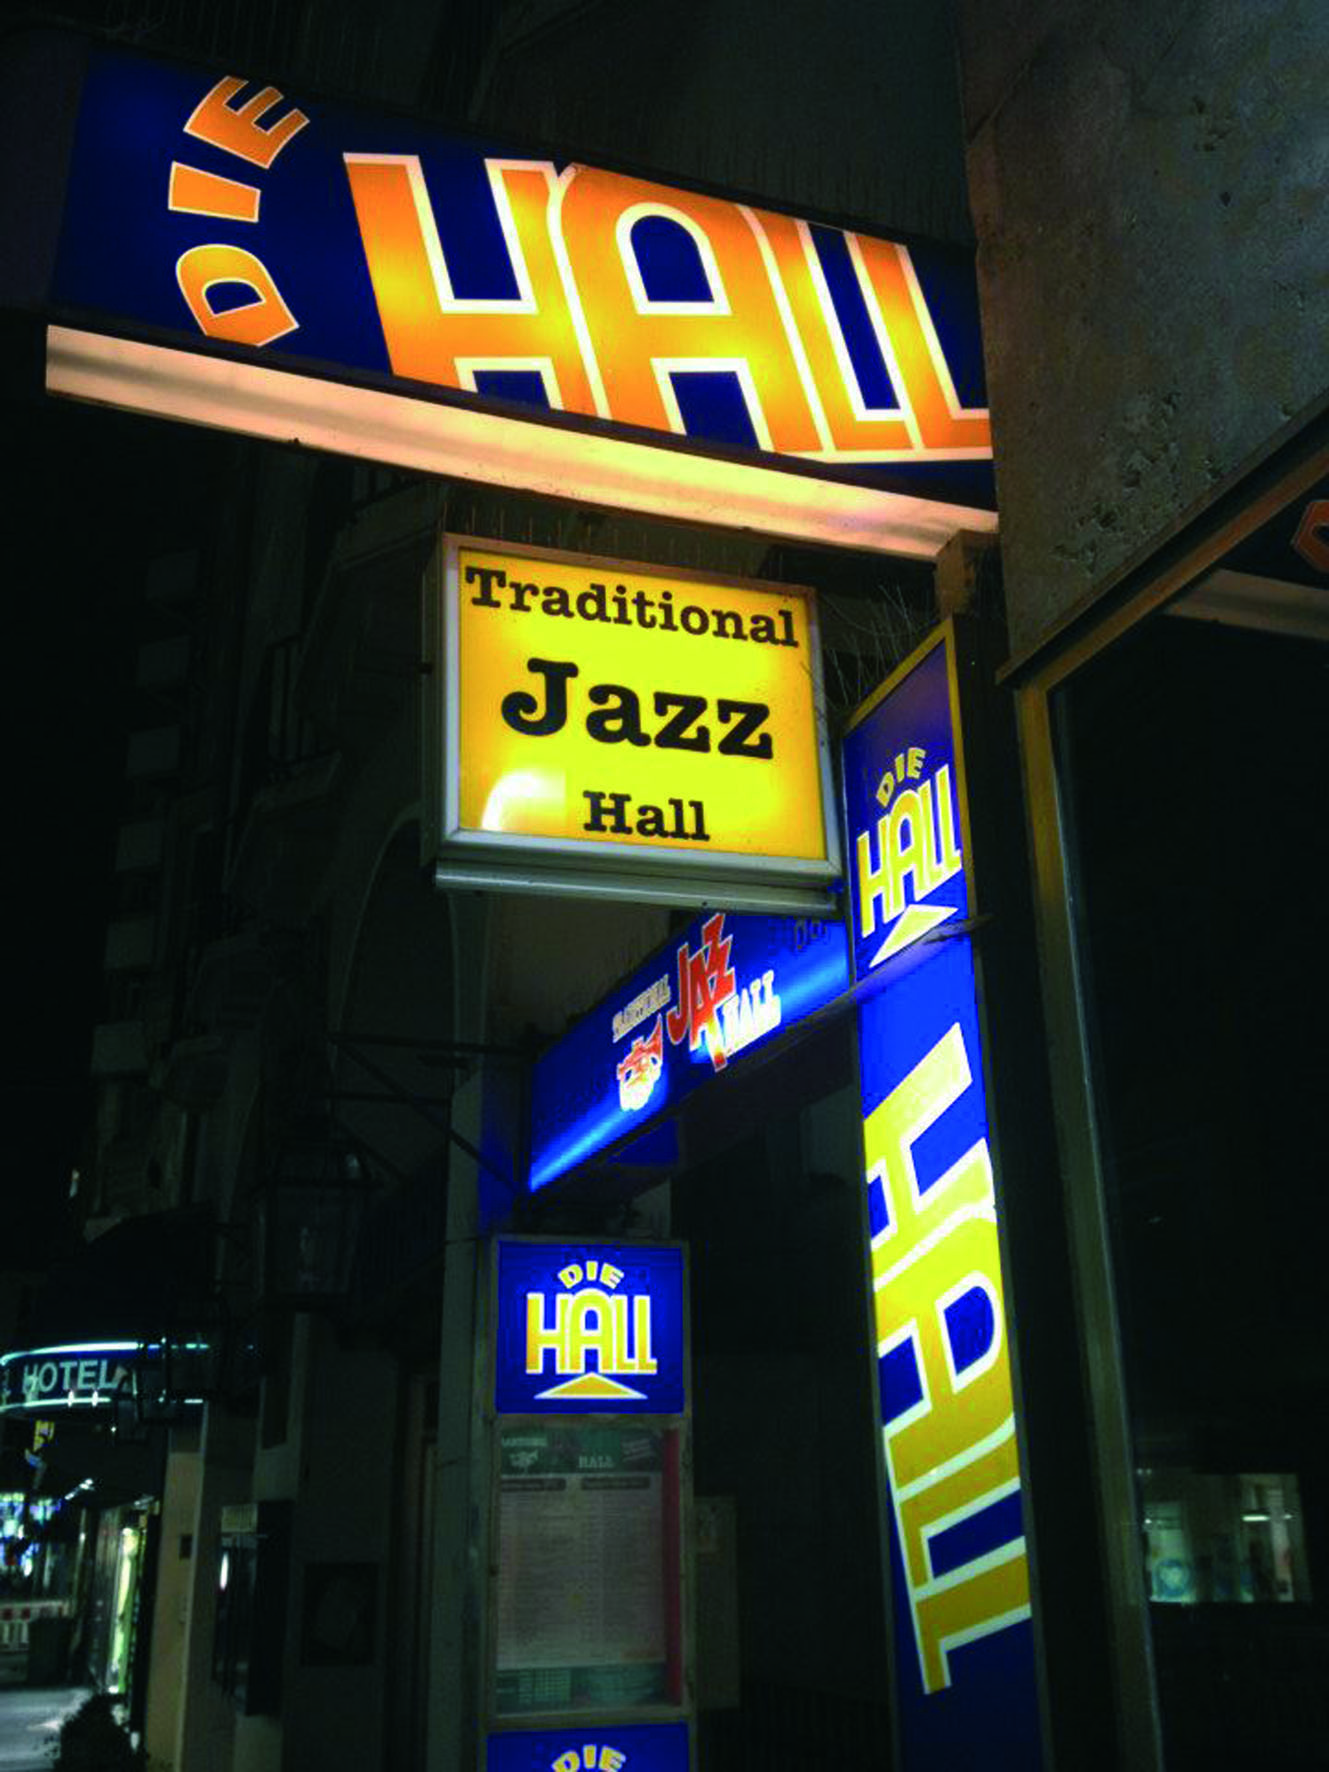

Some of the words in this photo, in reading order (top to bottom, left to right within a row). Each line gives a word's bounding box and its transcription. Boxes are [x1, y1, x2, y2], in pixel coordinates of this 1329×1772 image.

[169, 75, 310, 346] DIE
[343, 152, 994, 464] HALL
[464, 565, 799, 648] Traditional
[501, 657, 773, 760] Jazz
[582, 789, 711, 842] Hall
[876, 746, 927, 808] DIE
[856, 763, 963, 939] HALL
[666, 913, 736, 1073] JAZZ
[558, 1260, 625, 1290] DIE
[525, 1288, 658, 1375] HALL
[862, 1021, 1033, 1696] HALL
[21, 1359, 119, 1396] HOTEL
[551, 1743, 627, 1772] DIE
